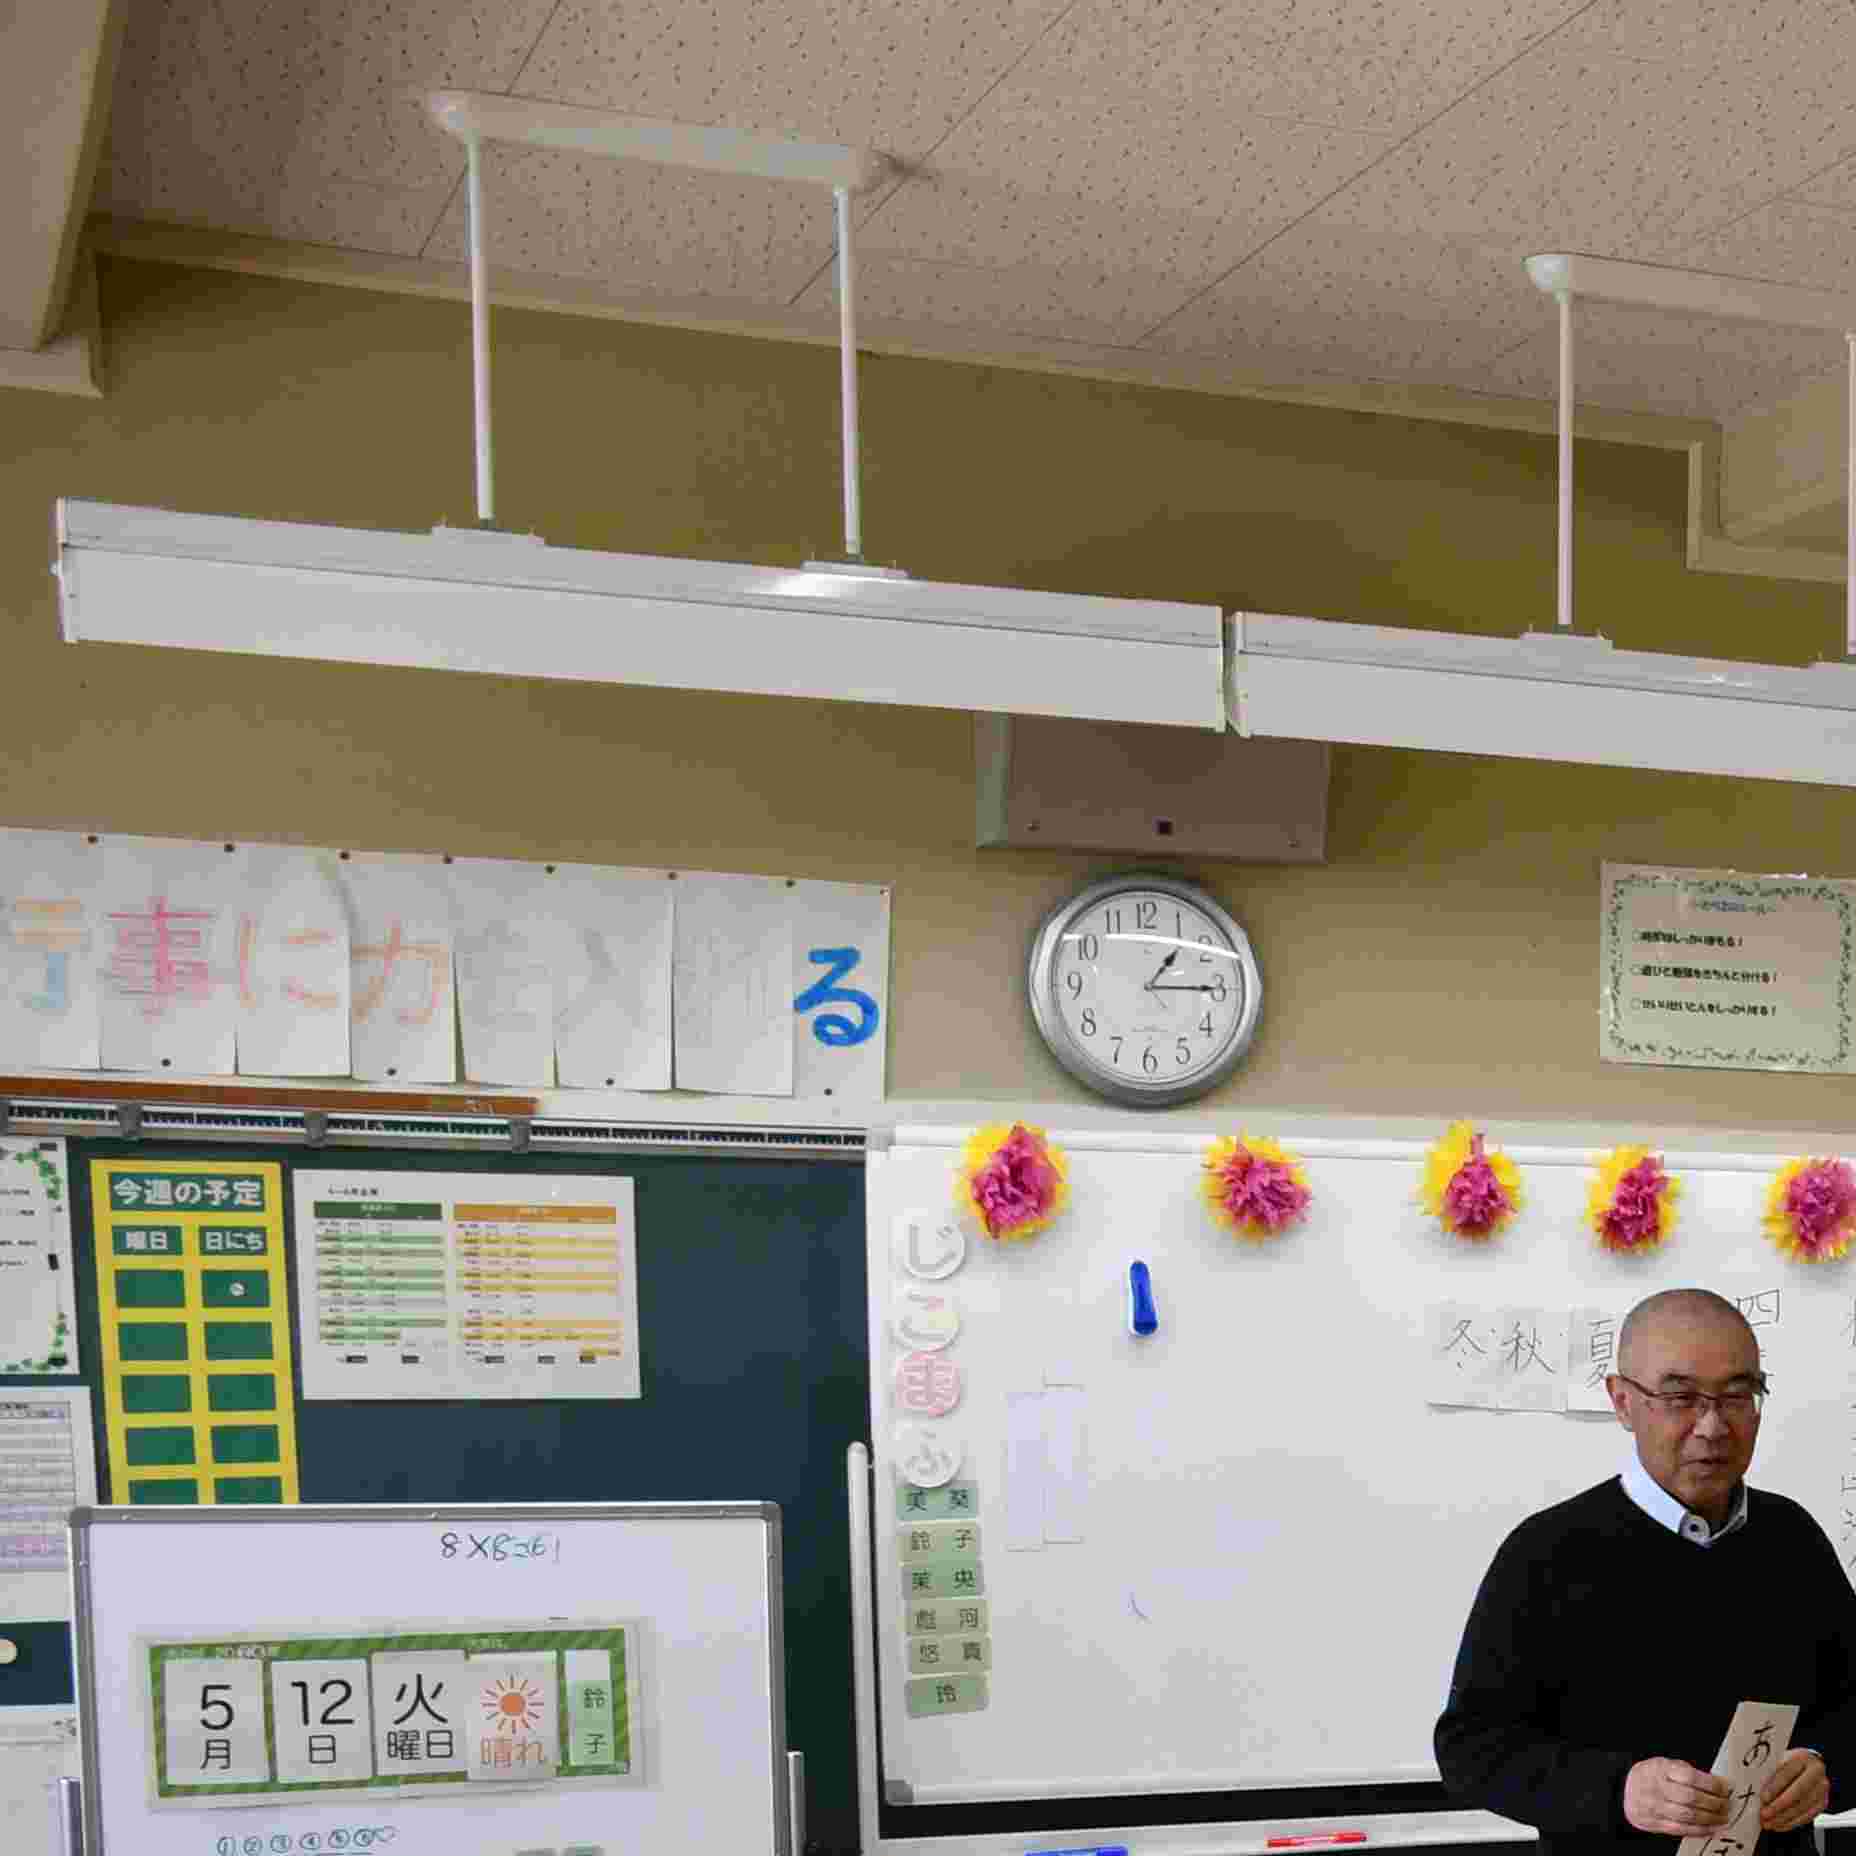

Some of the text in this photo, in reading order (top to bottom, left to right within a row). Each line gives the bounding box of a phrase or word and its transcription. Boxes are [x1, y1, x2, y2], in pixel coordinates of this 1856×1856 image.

[1106, 909, 1121, 934] 11
[1136, 902, 1157, 929] 12
[1176, 911, 1182, 938] 1
[1078, 935, 1098, 960] 10
[1198, 935, 1213, 962] 2
[1067, 972, 1082, 1000] 9
[1211, 974, 1227, 1001] 3
[1081, 1008, 1097, 1036] 8
[1199, 1010, 1213, 1037] 4
[1110, 1036, 1123, 1064] 7
[1143, 1046, 1158, 1073] 6
[1176, 1037, 1191, 1064] 5
[113, 1178, 262, 1206] 今週の予定
[126, 1230, 264, 1250] 曜日 日にち
[1444, 1318, 1487, 1369] 冬
[1500, 1320, 1556, 1374] 秋
[199, 1673, 449, 1730] 5 12 火
[199, 1729, 545, 1775] 月 日 曜日 晴れ
